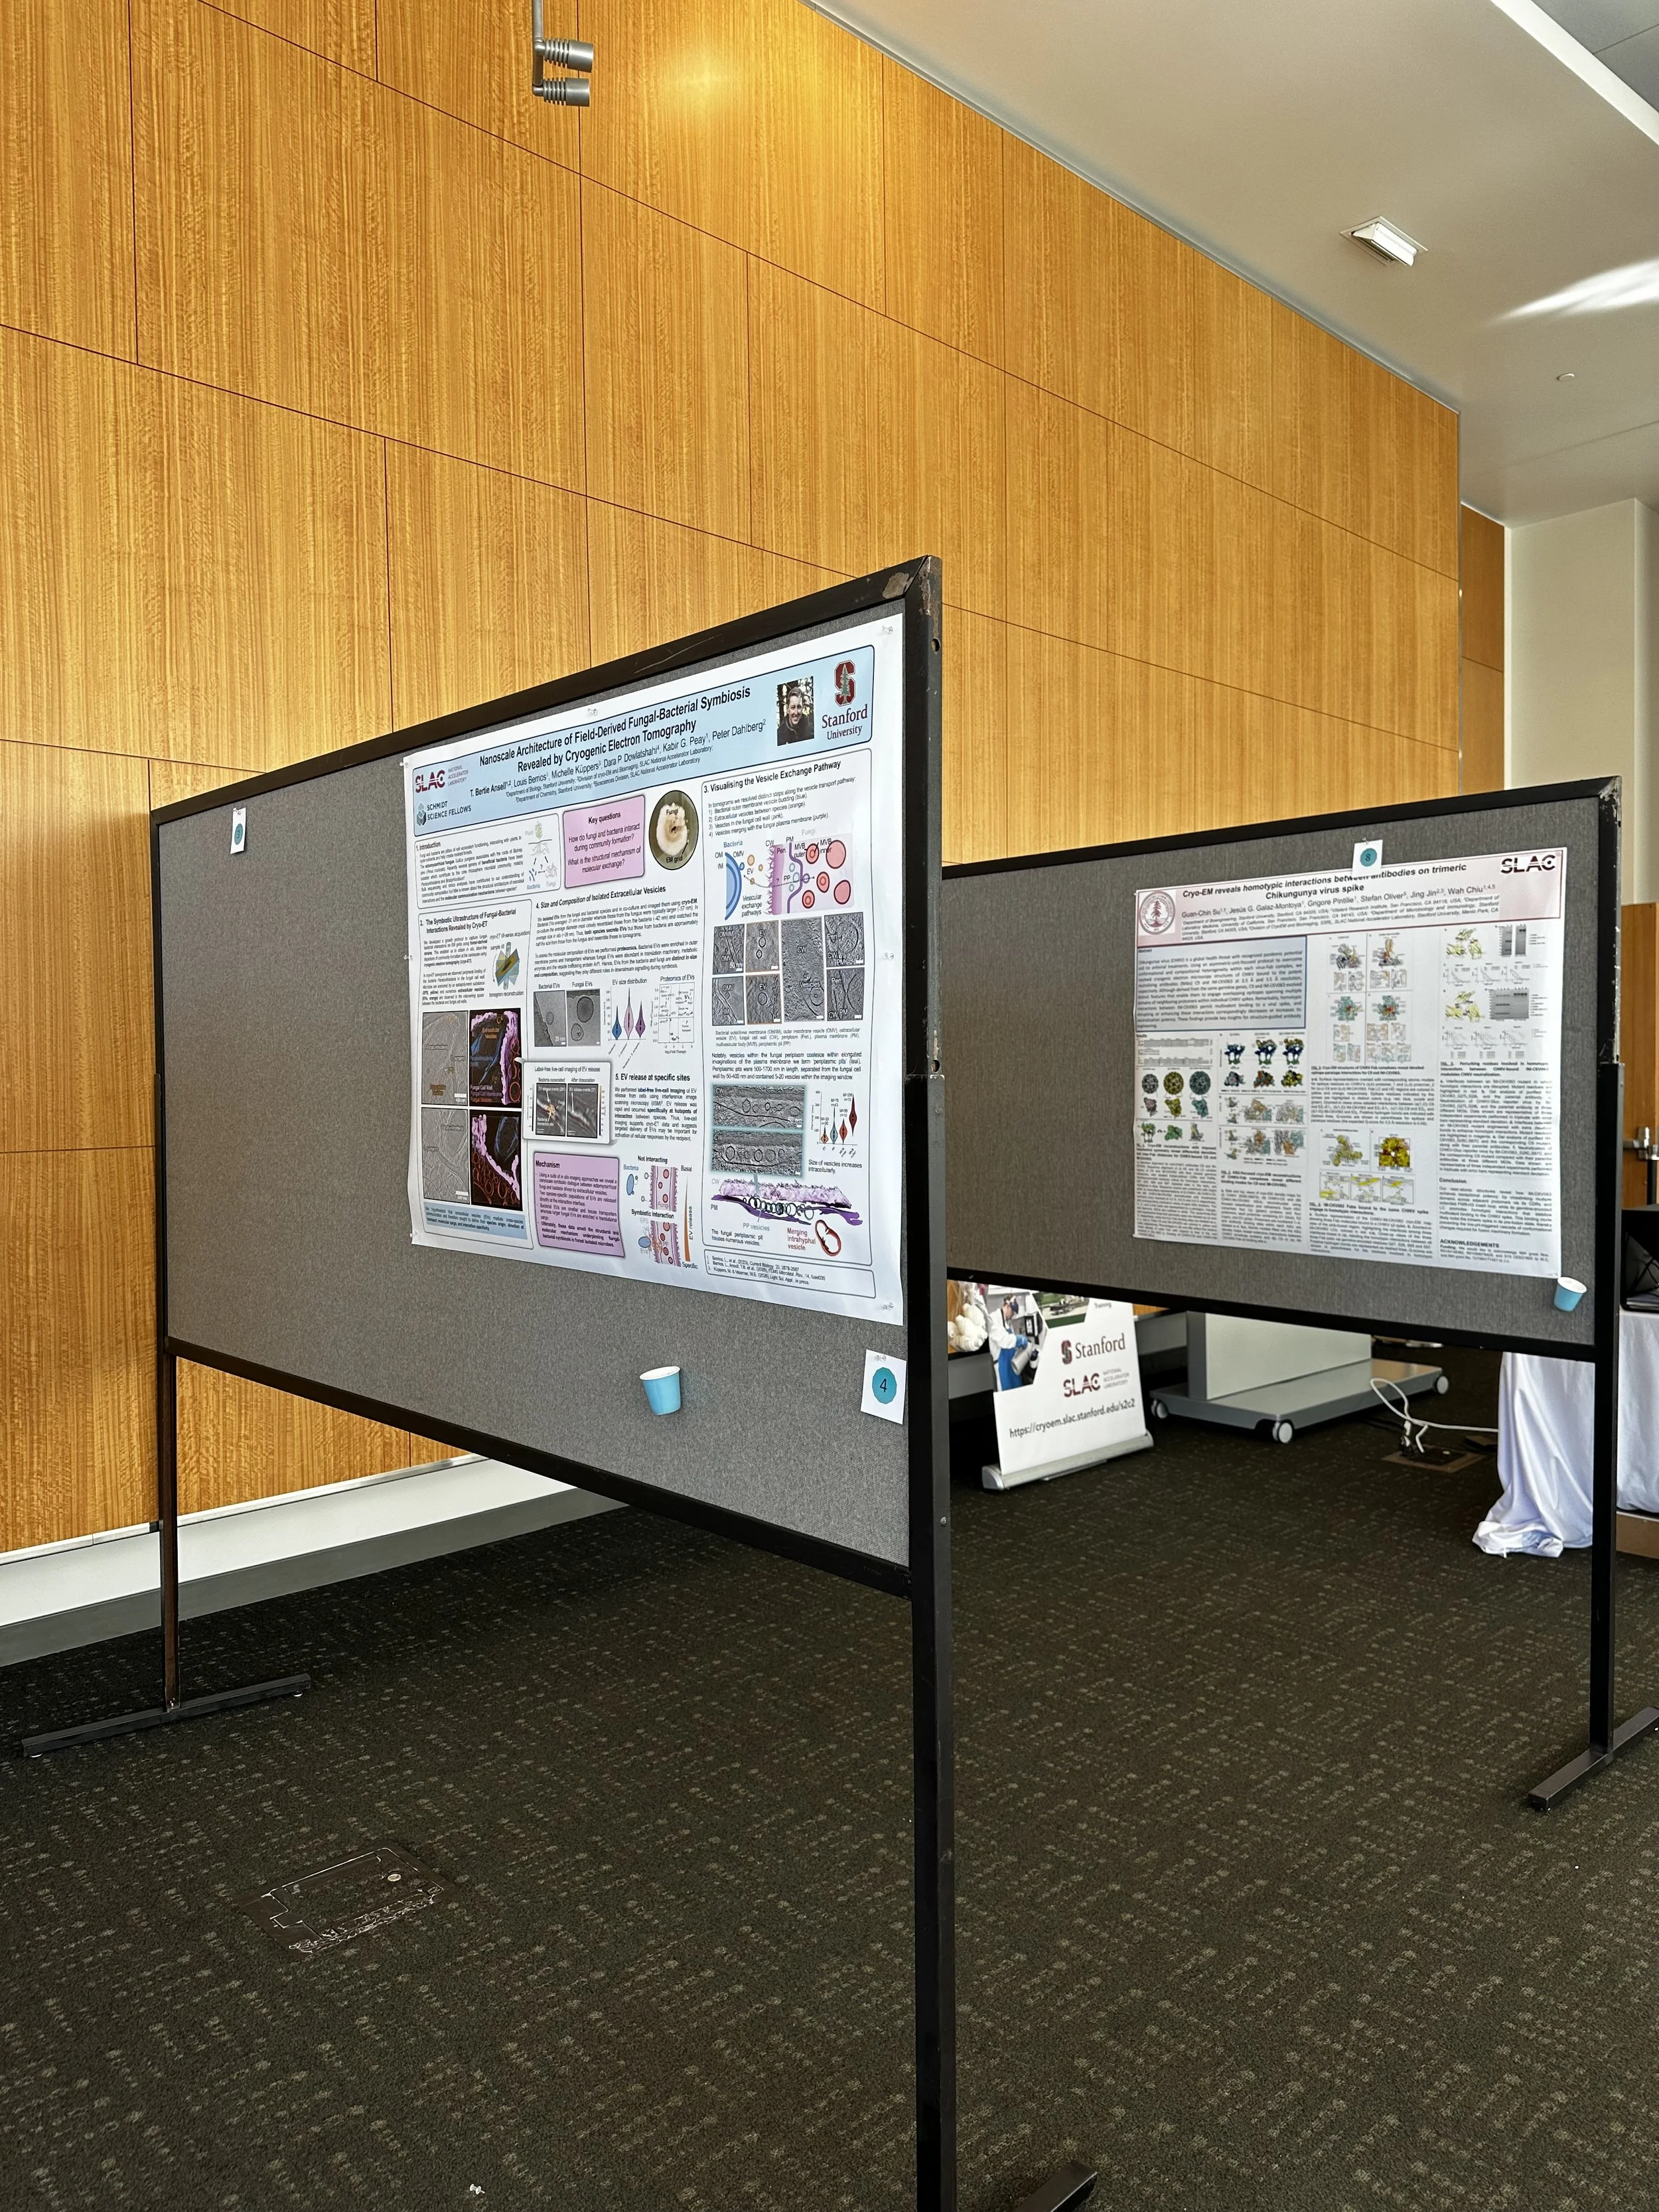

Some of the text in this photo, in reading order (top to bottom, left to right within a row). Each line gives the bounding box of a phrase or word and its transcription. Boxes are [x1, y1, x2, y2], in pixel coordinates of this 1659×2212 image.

[822, 704, 867, 728] Stanford
[480, 688, 750, 765] Nanoscale Architecture of Field-Derived Fungal-Bacterial Symbiosis
[827, 725, 863, 739] University
[518, 720, 695, 771] Revealed by Cryogenic Electron Tomography
[475, 786, 489, 796] Bertie
[551, 767, 573, 778] Michelle
[603, 759, 616, 767] Dara
[617, 755, 622, 763] P.
[663, 742, 678, 751] Kabir
[680, 738, 687, 747] G.
[712, 729, 729, 739] Peter
[415, 770, 445, 793] SLAC
[448, 777, 467, 786] LABORATORY
[710, 780, 743, 791] Visualising
[755, 773, 778, 782] Vesicle
[780, 767, 812, 778] Exchange
[814, 761, 840, 771] Pathway
[427, 801, 448, 811] SCHMIDT
[427, 806, 471, 820] SCIENCE FELLOWS
[599, 812, 620, 822] questions
[624, 823, 640, 832] interact
[419, 842, 441, 851] Introduction
[589, 839, 611, 849] community
[611, 833, 634, 844] formation?
[591, 852, 610, 861] structural
[611, 848, 635, 857] mechanism
[674, 855, 684, 864] grid
[601, 859, 624, 869] exchange?
[1501, 855, 1556, 874] SLAC
[1183, 888, 1213, 897] Cryo-EM
[1243, 882, 1282, 891] homotypic
[1285, 877, 1331, 887] interactions
[1370, 869, 1415, 878] antibodies
[1432, 863, 1466, 873] trimeric
[559, 897, 585, 905] Composition
[611, 889, 642, 898] Extracellular
[1265, 889, 1317, 899] Chikungunya
[1342, 884, 1364, 893] spike
[433, 917, 452, 925] Symbiotic
[484, 909, 516, 919] Fungal-Bacterial
[472, 921, 487, 929] Cryo-ET
[536, 1160, 560, 1169] Mechanism
[787, 1228, 808, 1237] Merging
[787, 1236, 816, 1245] intrahyphal
[1440, 1238, 1500, 1248] ACKNOWLEDGEMENTS
[1075, 1333, 1125, 1359] Stanford
[880, 1378, 887, 1392] 4
[1063, 1372, 1100, 1398] SLAC
[1009, 1399, 1135, 1438] https://cryoem.slac.stanford.edu/s2c2
